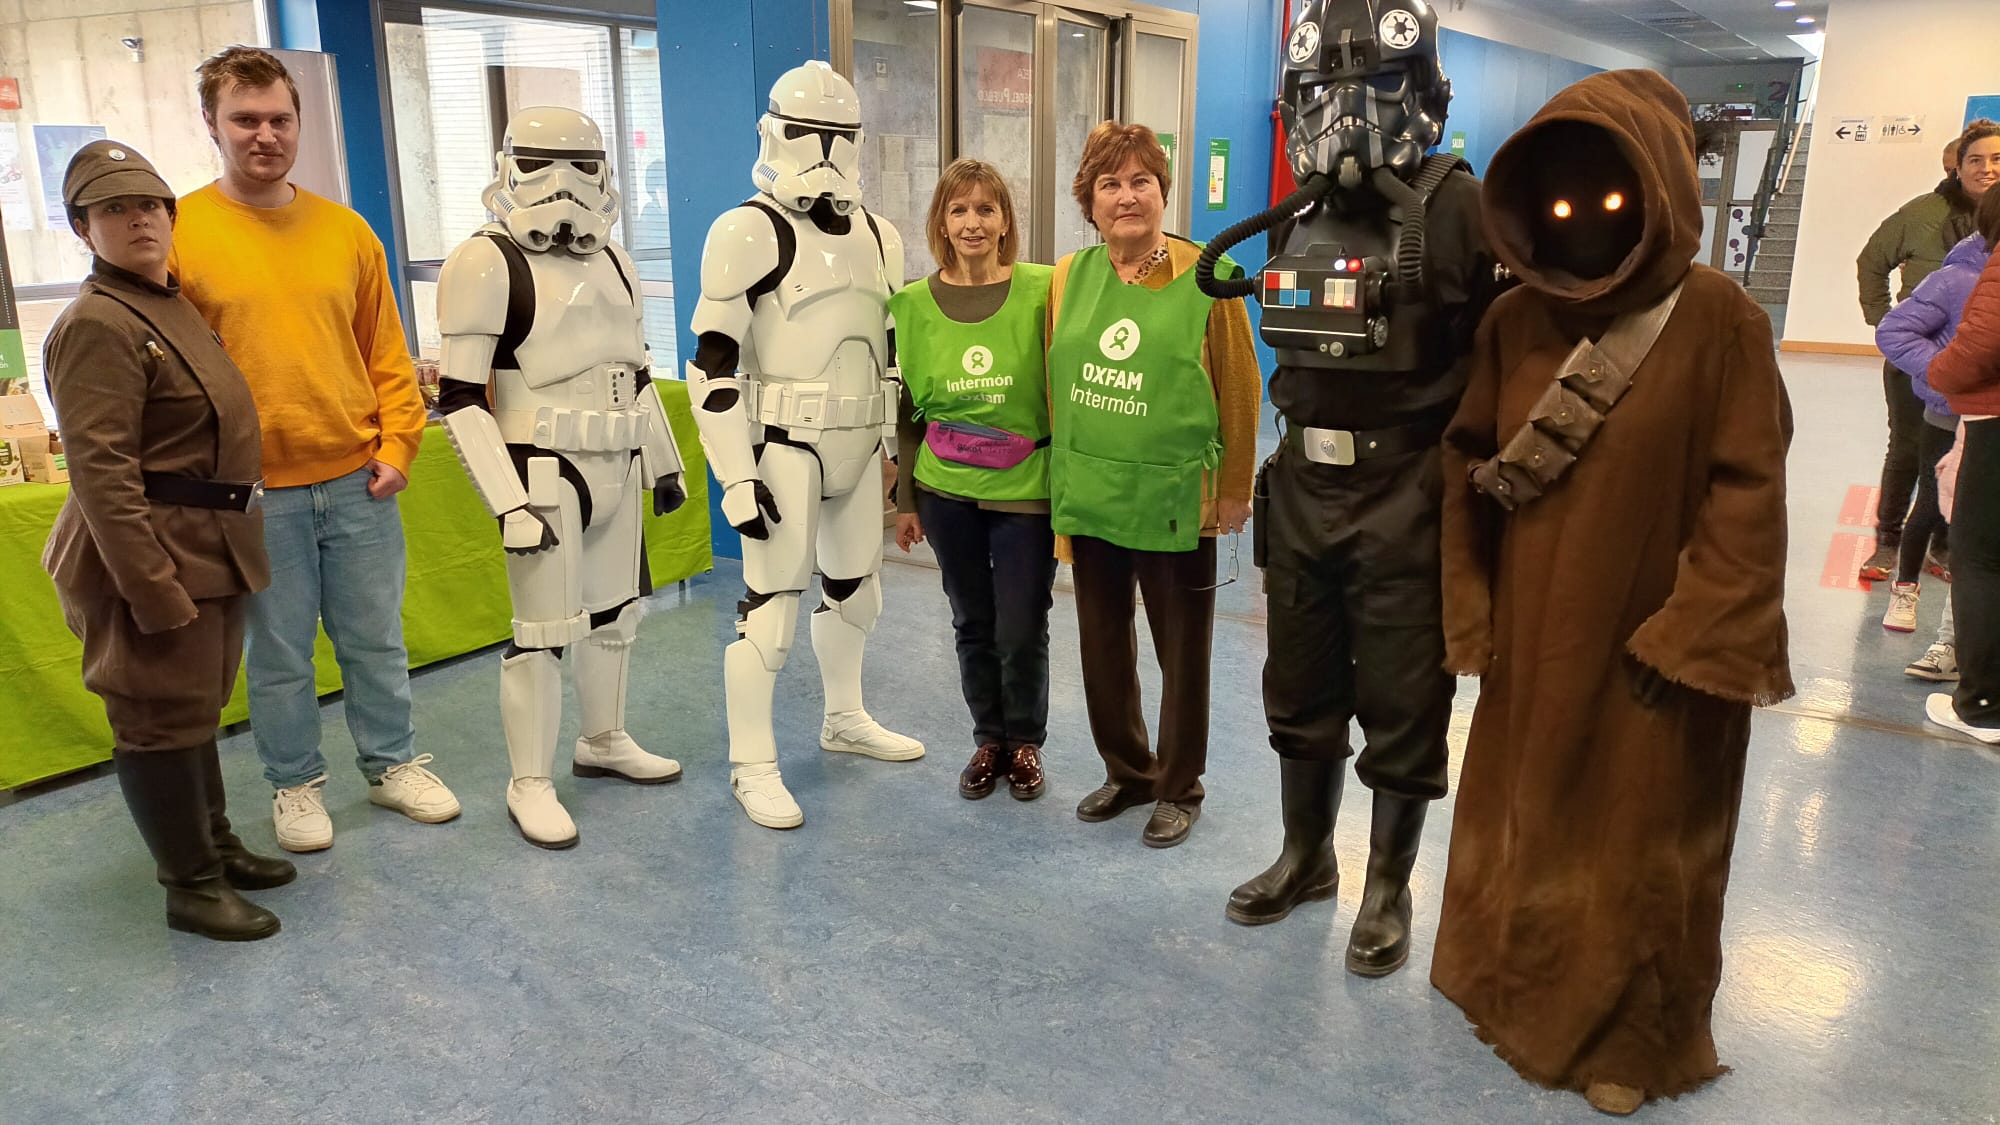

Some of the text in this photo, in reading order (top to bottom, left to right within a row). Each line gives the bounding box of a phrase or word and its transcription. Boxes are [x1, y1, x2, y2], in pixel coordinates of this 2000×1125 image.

[946, 374, 1013, 393] Intermón
[1083, 362, 1143, 391] OXFAM
[1070, 383, 1148, 417] Intermón
